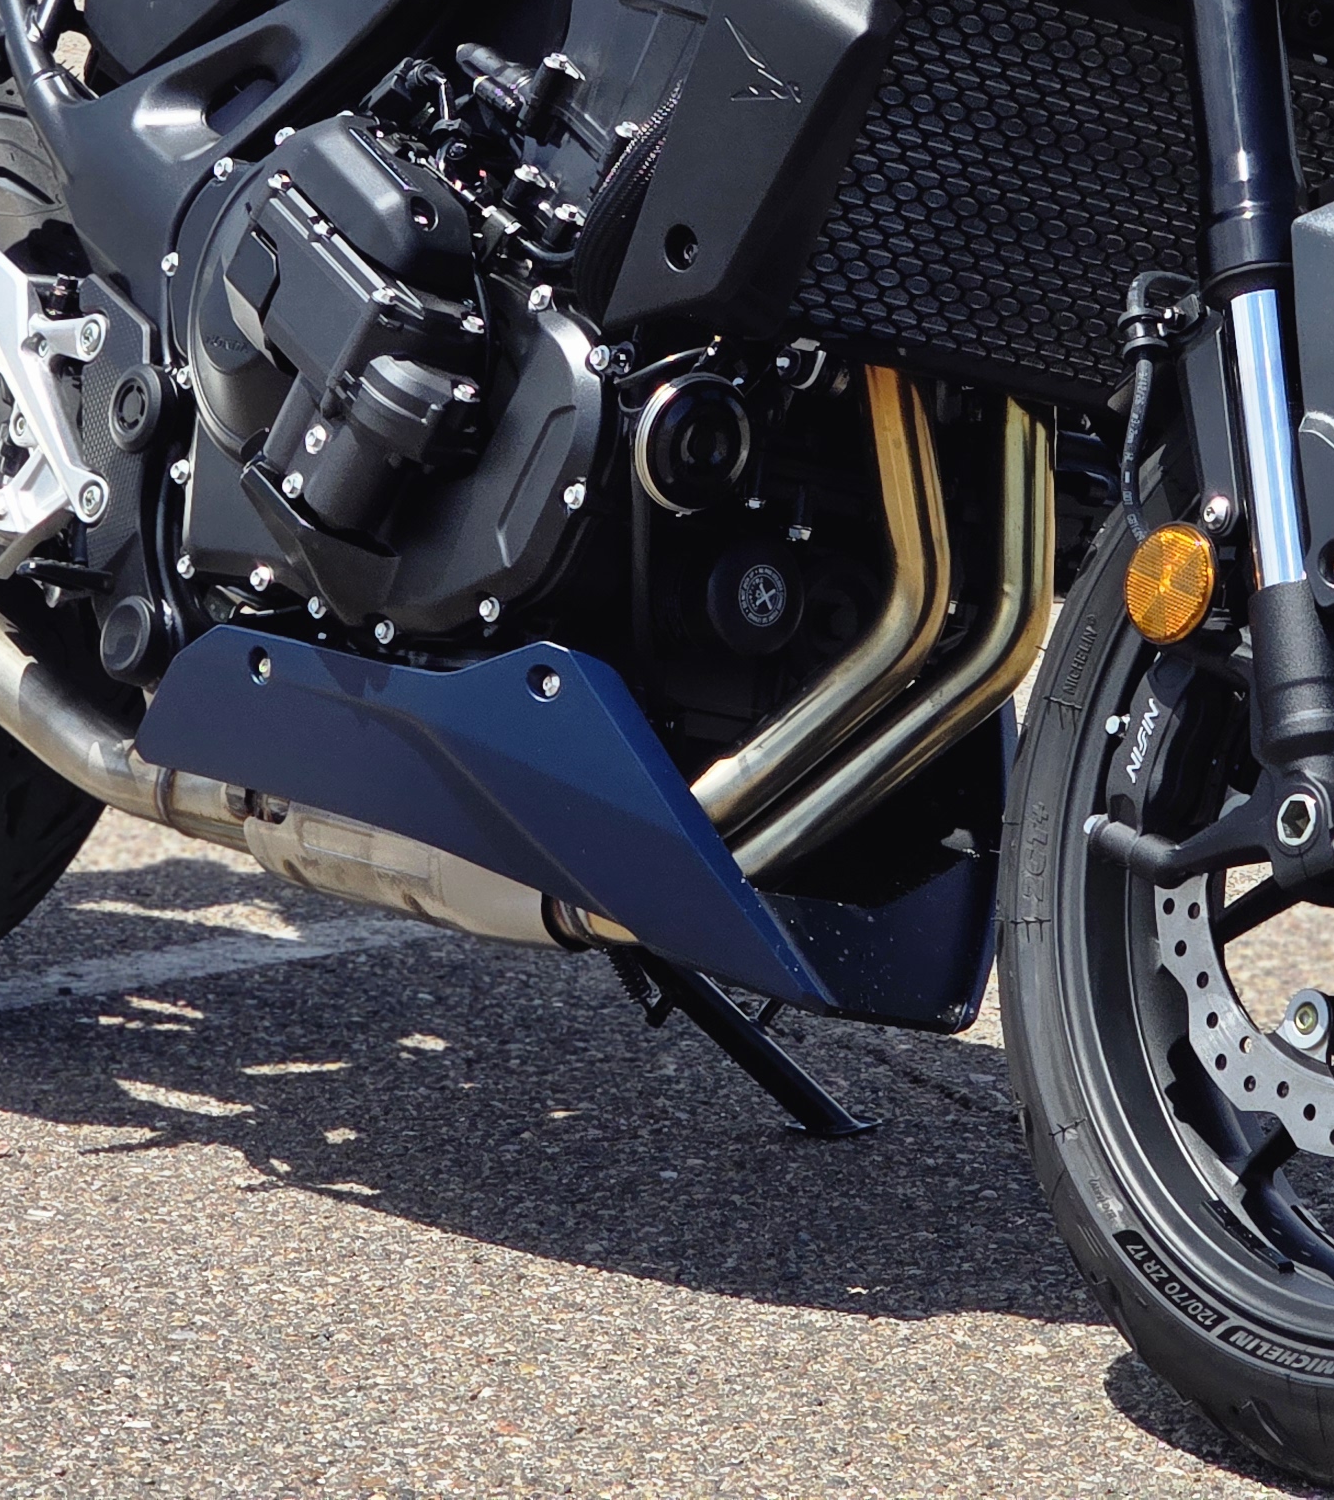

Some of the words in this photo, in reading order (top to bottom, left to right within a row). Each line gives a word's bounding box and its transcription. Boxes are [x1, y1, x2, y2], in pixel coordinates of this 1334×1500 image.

[1063, 625, 1098, 695] MICHELIN
[1126, 1243, 1149, 1260] 17
[1142, 1260, 1168, 1283] ZR
[1164, 1282, 1217, 1326] 120/70
